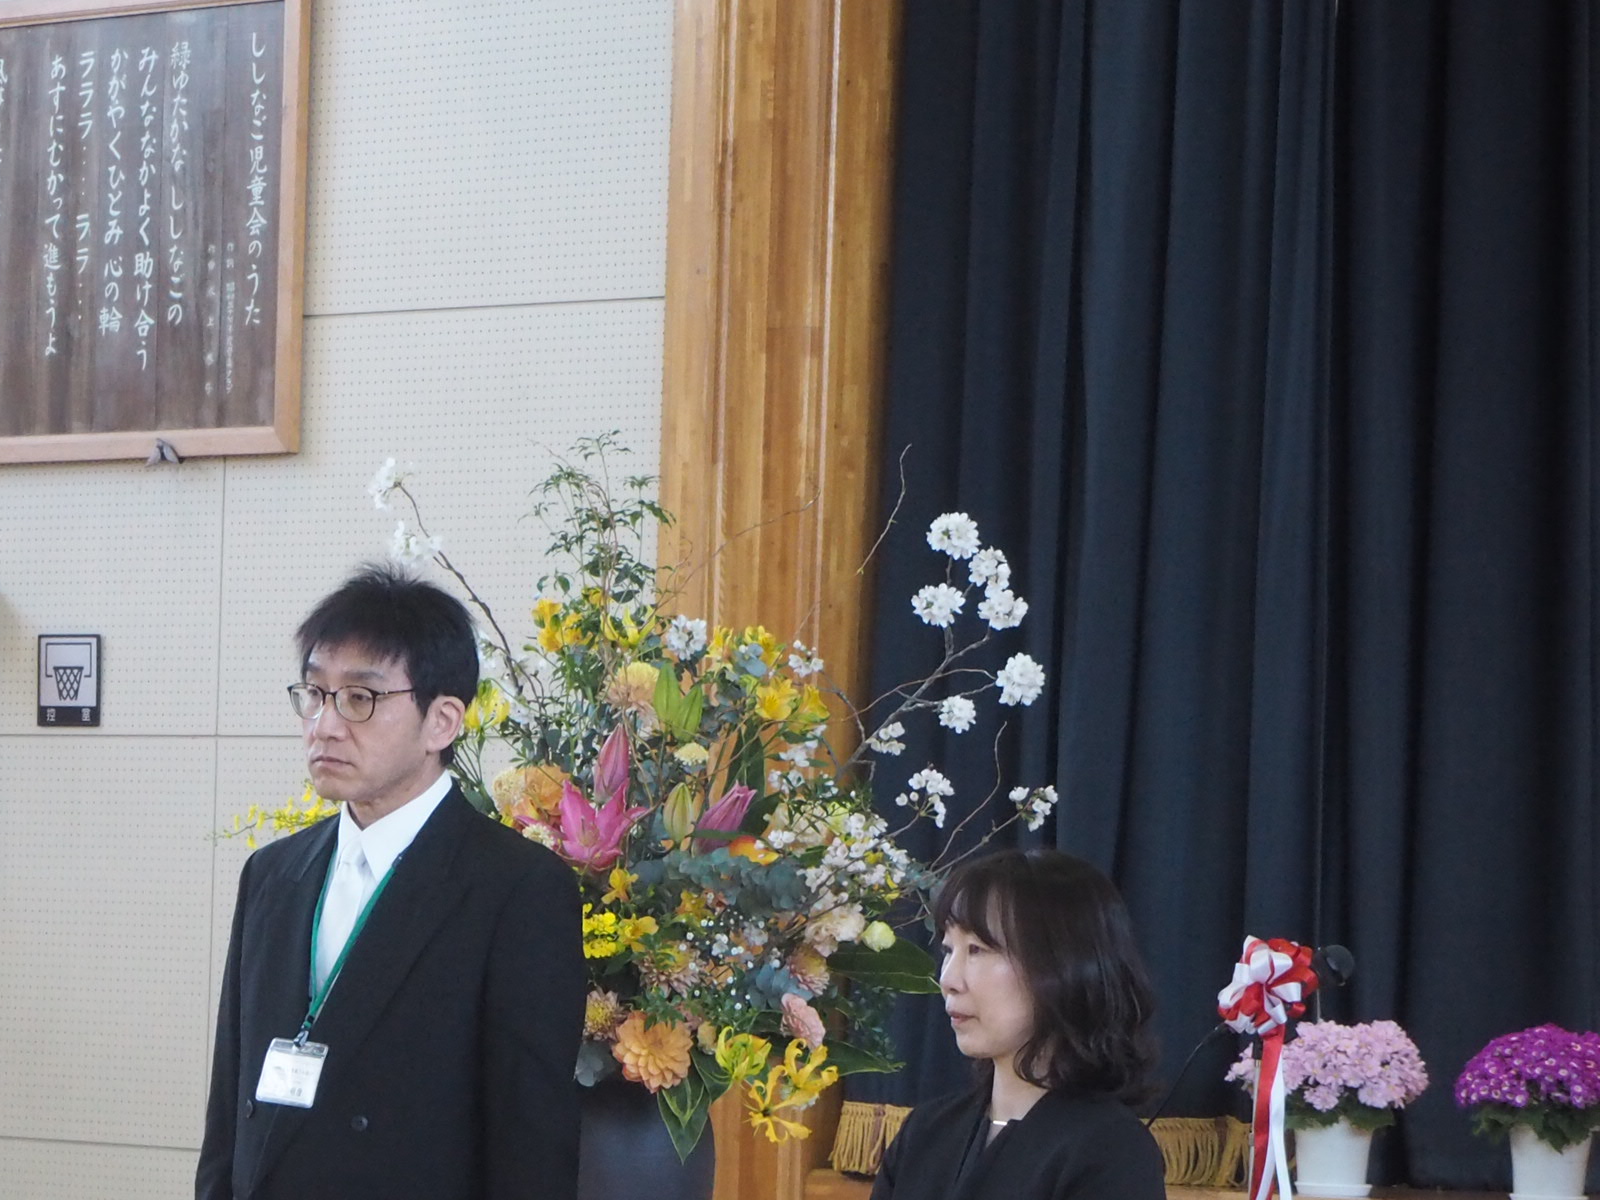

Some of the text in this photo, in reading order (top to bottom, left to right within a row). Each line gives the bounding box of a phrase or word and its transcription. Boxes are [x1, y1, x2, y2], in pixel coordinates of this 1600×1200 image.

[244, 31, 268, 327] ししなご児童会のうた
